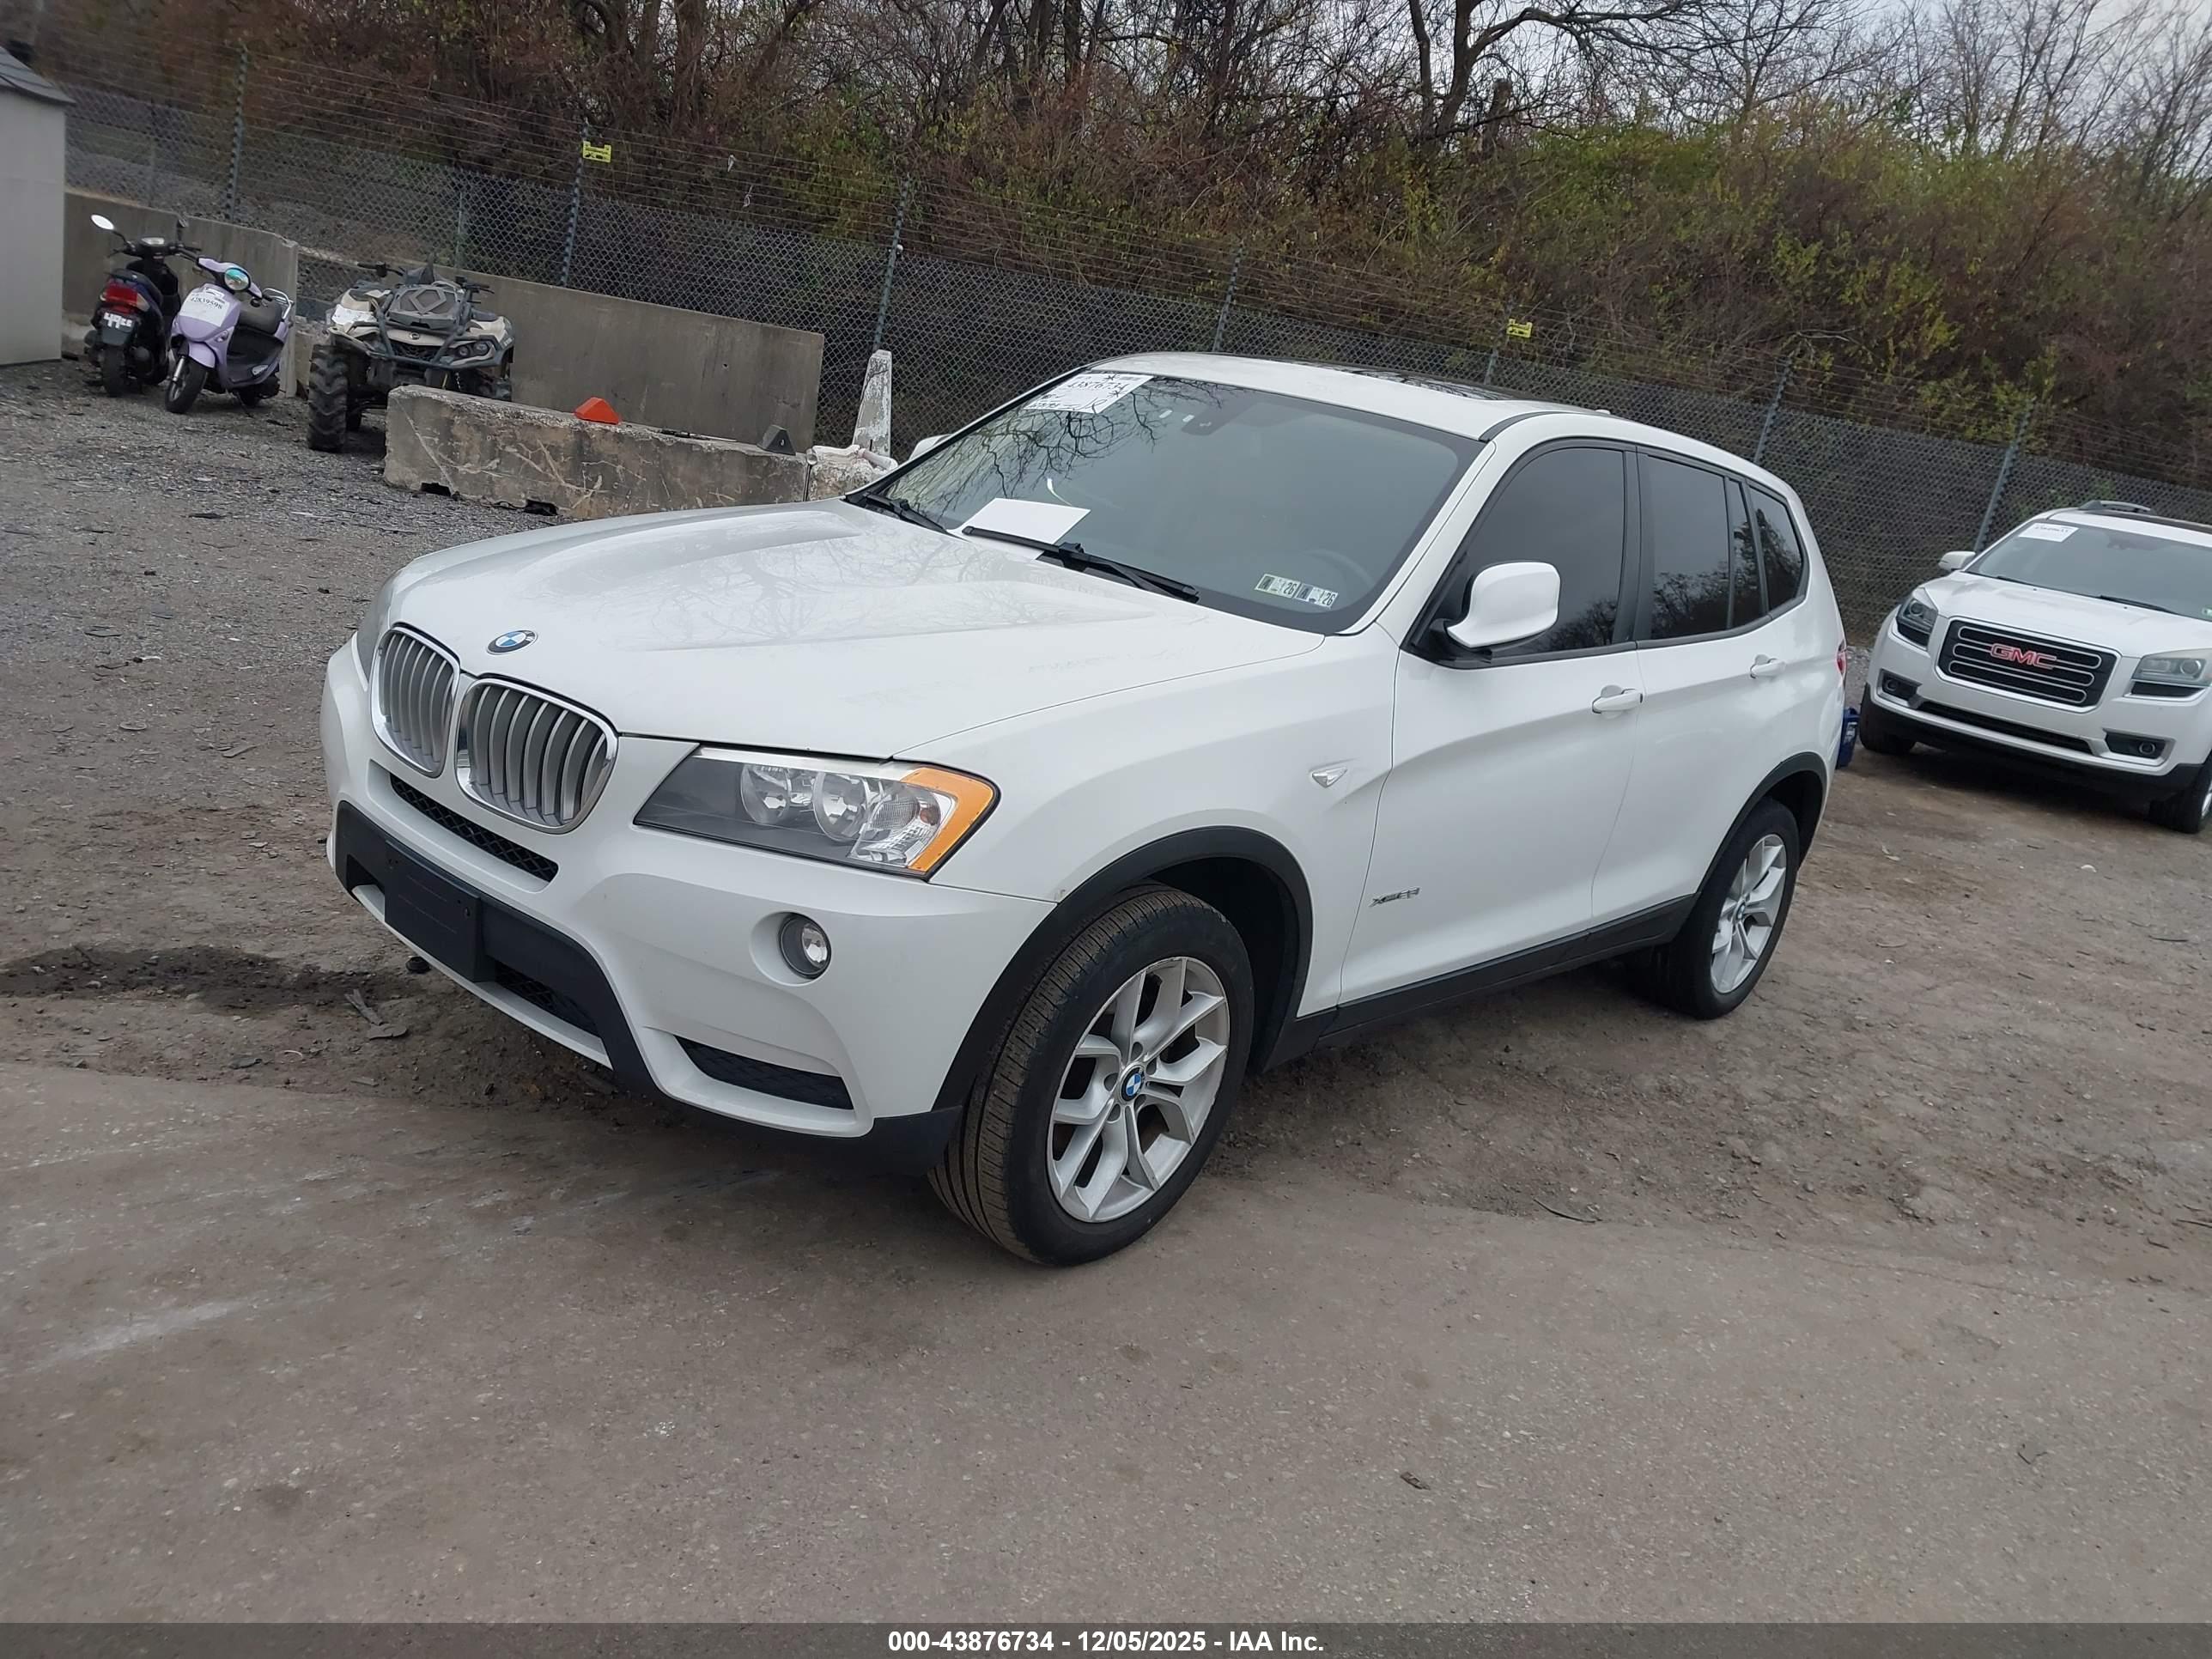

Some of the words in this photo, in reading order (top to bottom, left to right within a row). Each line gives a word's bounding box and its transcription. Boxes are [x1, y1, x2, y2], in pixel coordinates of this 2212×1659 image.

[1283, 581, 1297, 595] 26
[1322, 592, 1336, 606] 26
[1990, 642, 2057, 670] GMC
